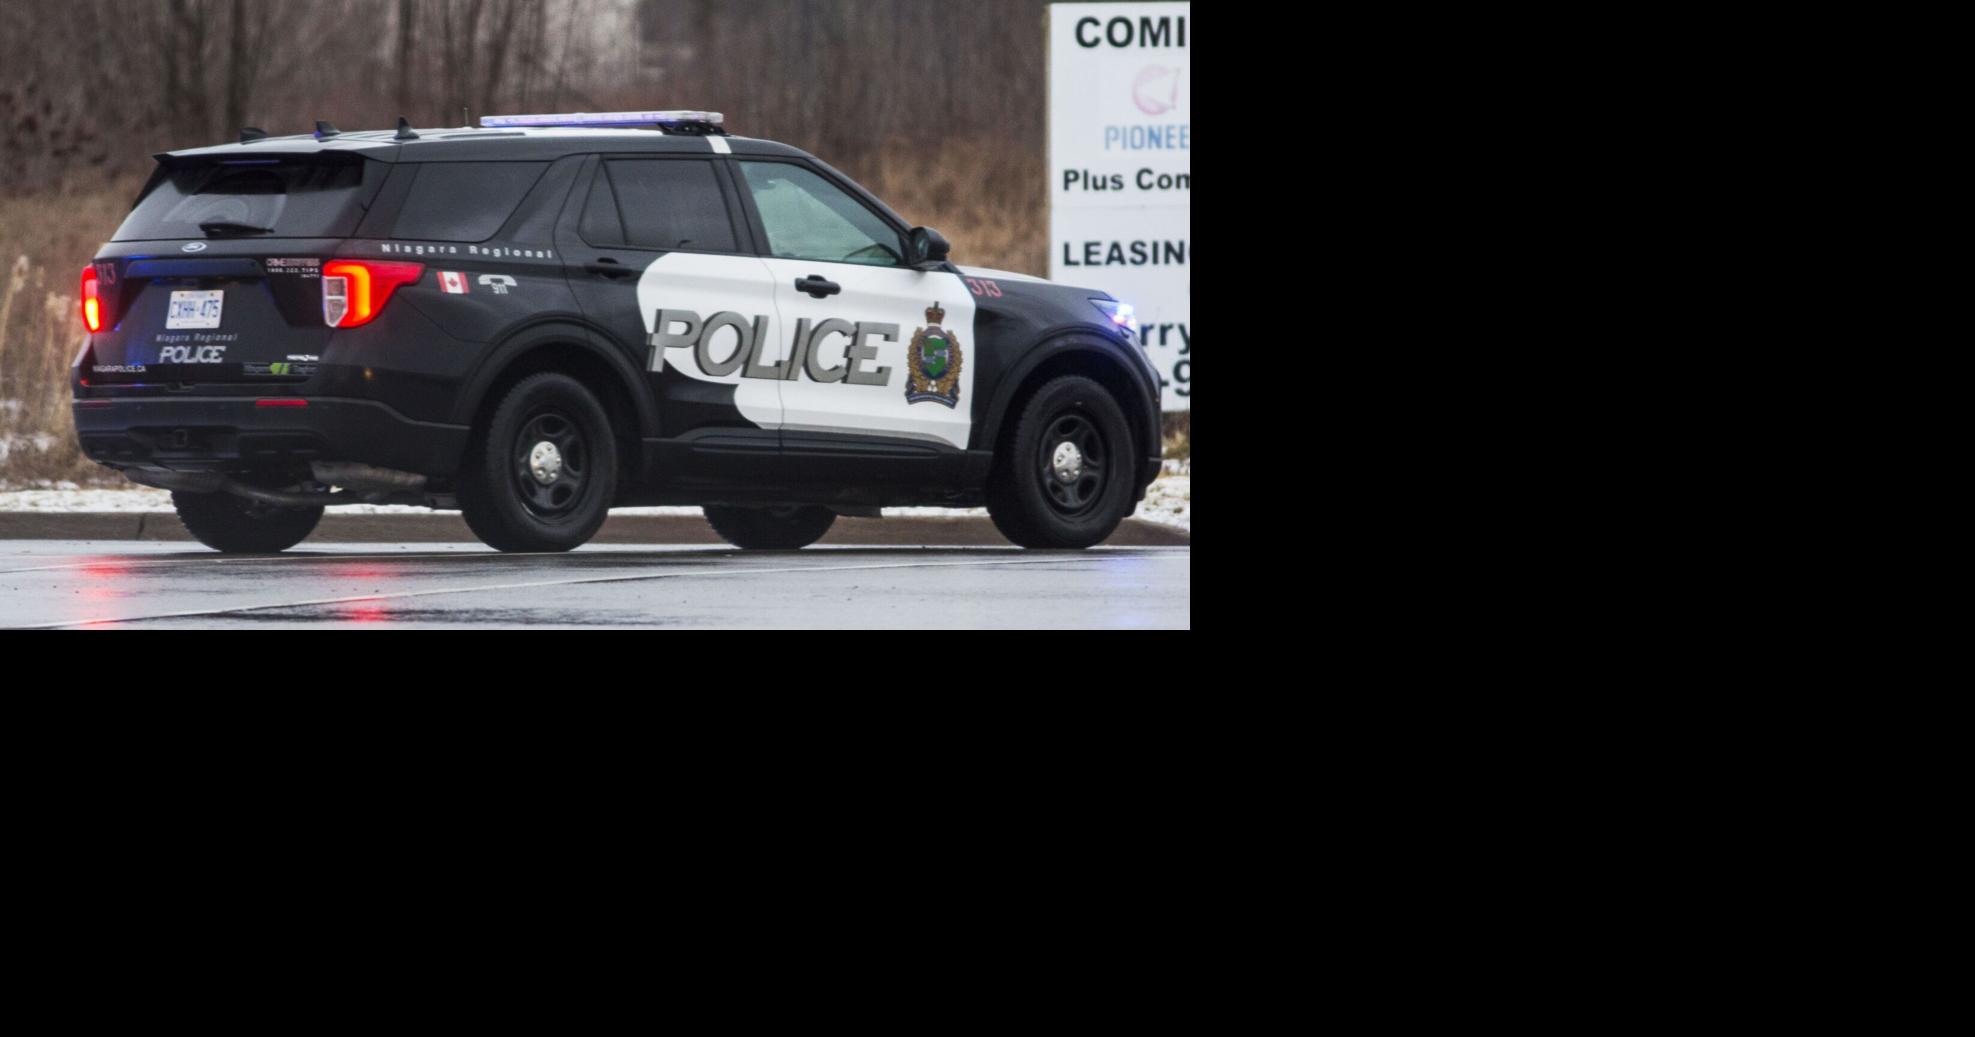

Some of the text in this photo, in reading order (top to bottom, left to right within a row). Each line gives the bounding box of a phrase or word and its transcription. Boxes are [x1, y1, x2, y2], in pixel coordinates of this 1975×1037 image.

[1075, 16, 1186, 48] COMI
[1105, 125, 1190, 150] PIONEE
[1063, 169, 1124, 191] Plus
[381, 243, 552, 258] Niagara Regional
[1063, 240, 1190, 266] LEASIN
[965, 278, 1002, 298] 313
[158, 345, 226, 363] POLICE
[645, 308, 899, 386] POLICE
